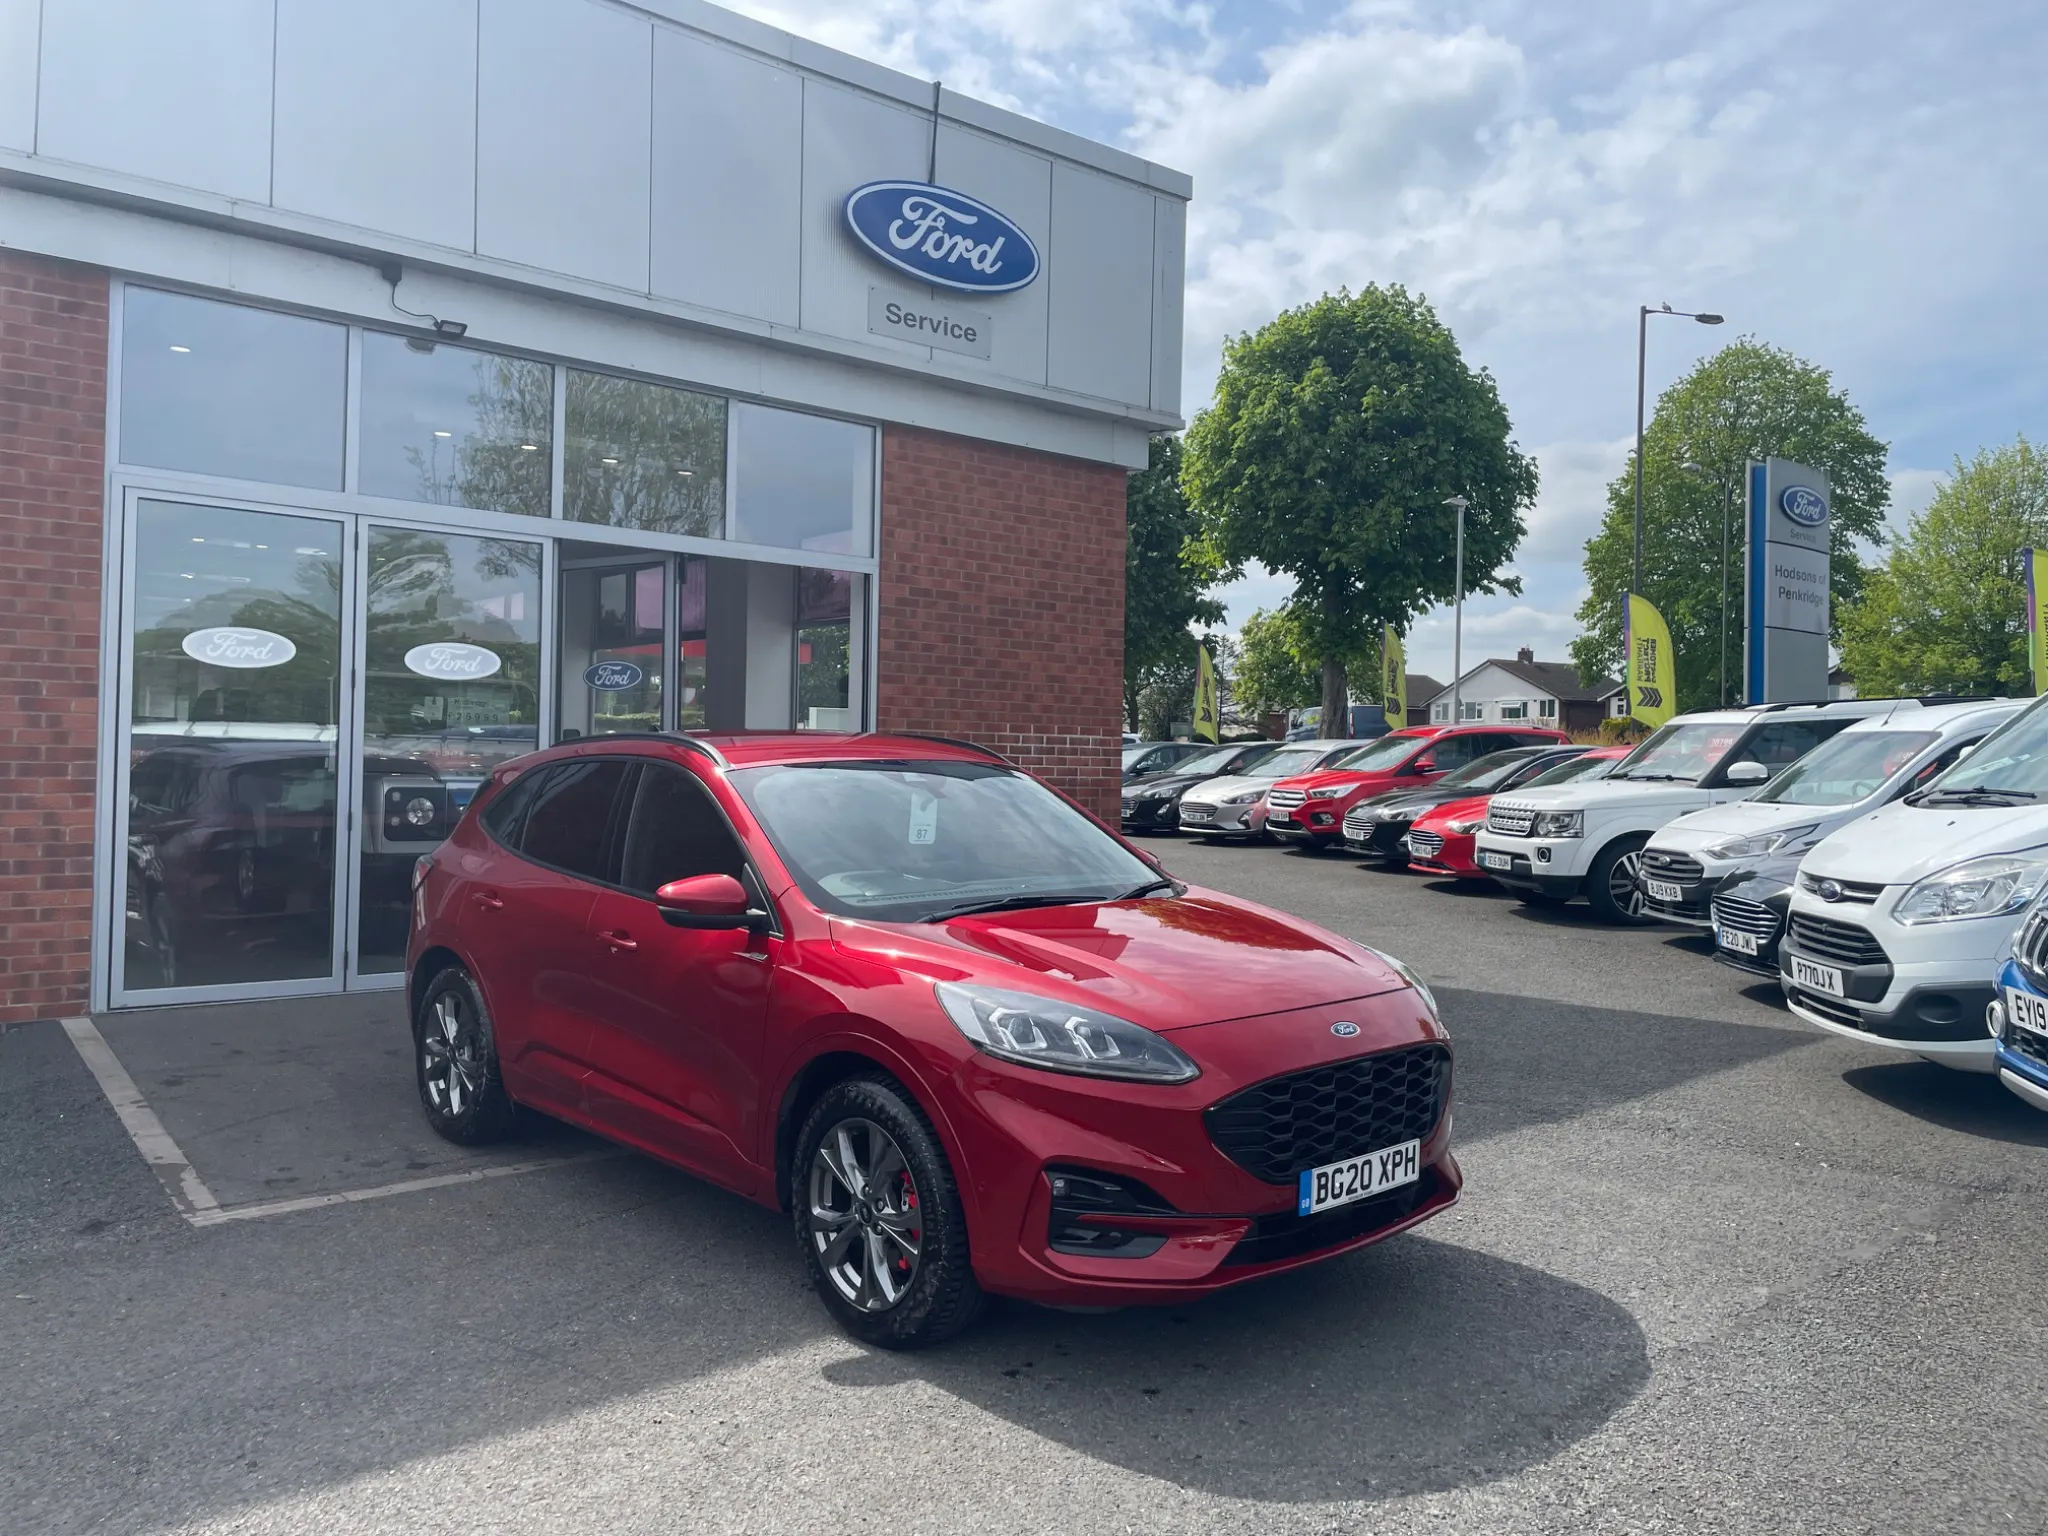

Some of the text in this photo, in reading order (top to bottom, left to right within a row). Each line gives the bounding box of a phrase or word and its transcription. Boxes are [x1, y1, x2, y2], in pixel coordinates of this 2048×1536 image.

[888, 196, 1006, 274] Ford
[885, 302, 977, 342] Service
[1793, 491, 1821, 520] Ford
[1775, 564, 1817, 584] Hodsons
[1778, 586, 1824, 607] Penkridge
[206, 632, 274, 660] Ford
[424, 647, 482, 672] Ford
[595, 664, 631, 685] Ford
[916, 829, 928, 840] 87
[1721, 930, 1755, 951] FE20 JWL
[2014, 993, 2047, 1030] EY19
[1315, 1144, 1416, 1205] BG20 XPH
